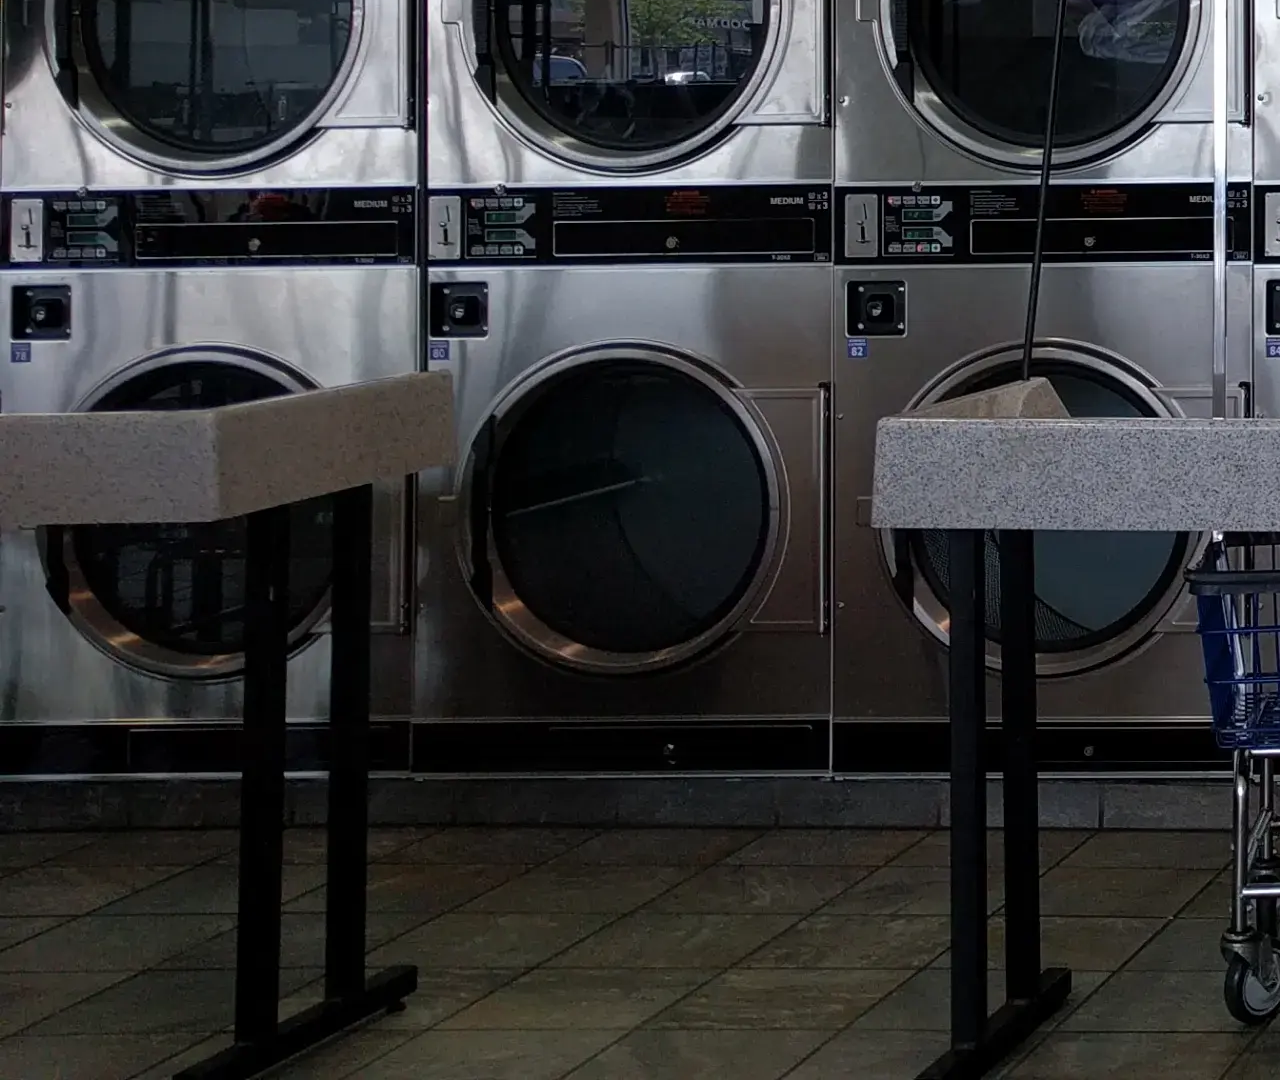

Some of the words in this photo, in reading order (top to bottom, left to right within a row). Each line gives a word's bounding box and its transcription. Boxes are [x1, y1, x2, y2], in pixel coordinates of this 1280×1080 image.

[353, 199, 388, 209] MEDIUM
[770, 196, 804, 205] MEDIUM
[432, 348, 445, 358] 80
[851, 347, 863, 356] 82
